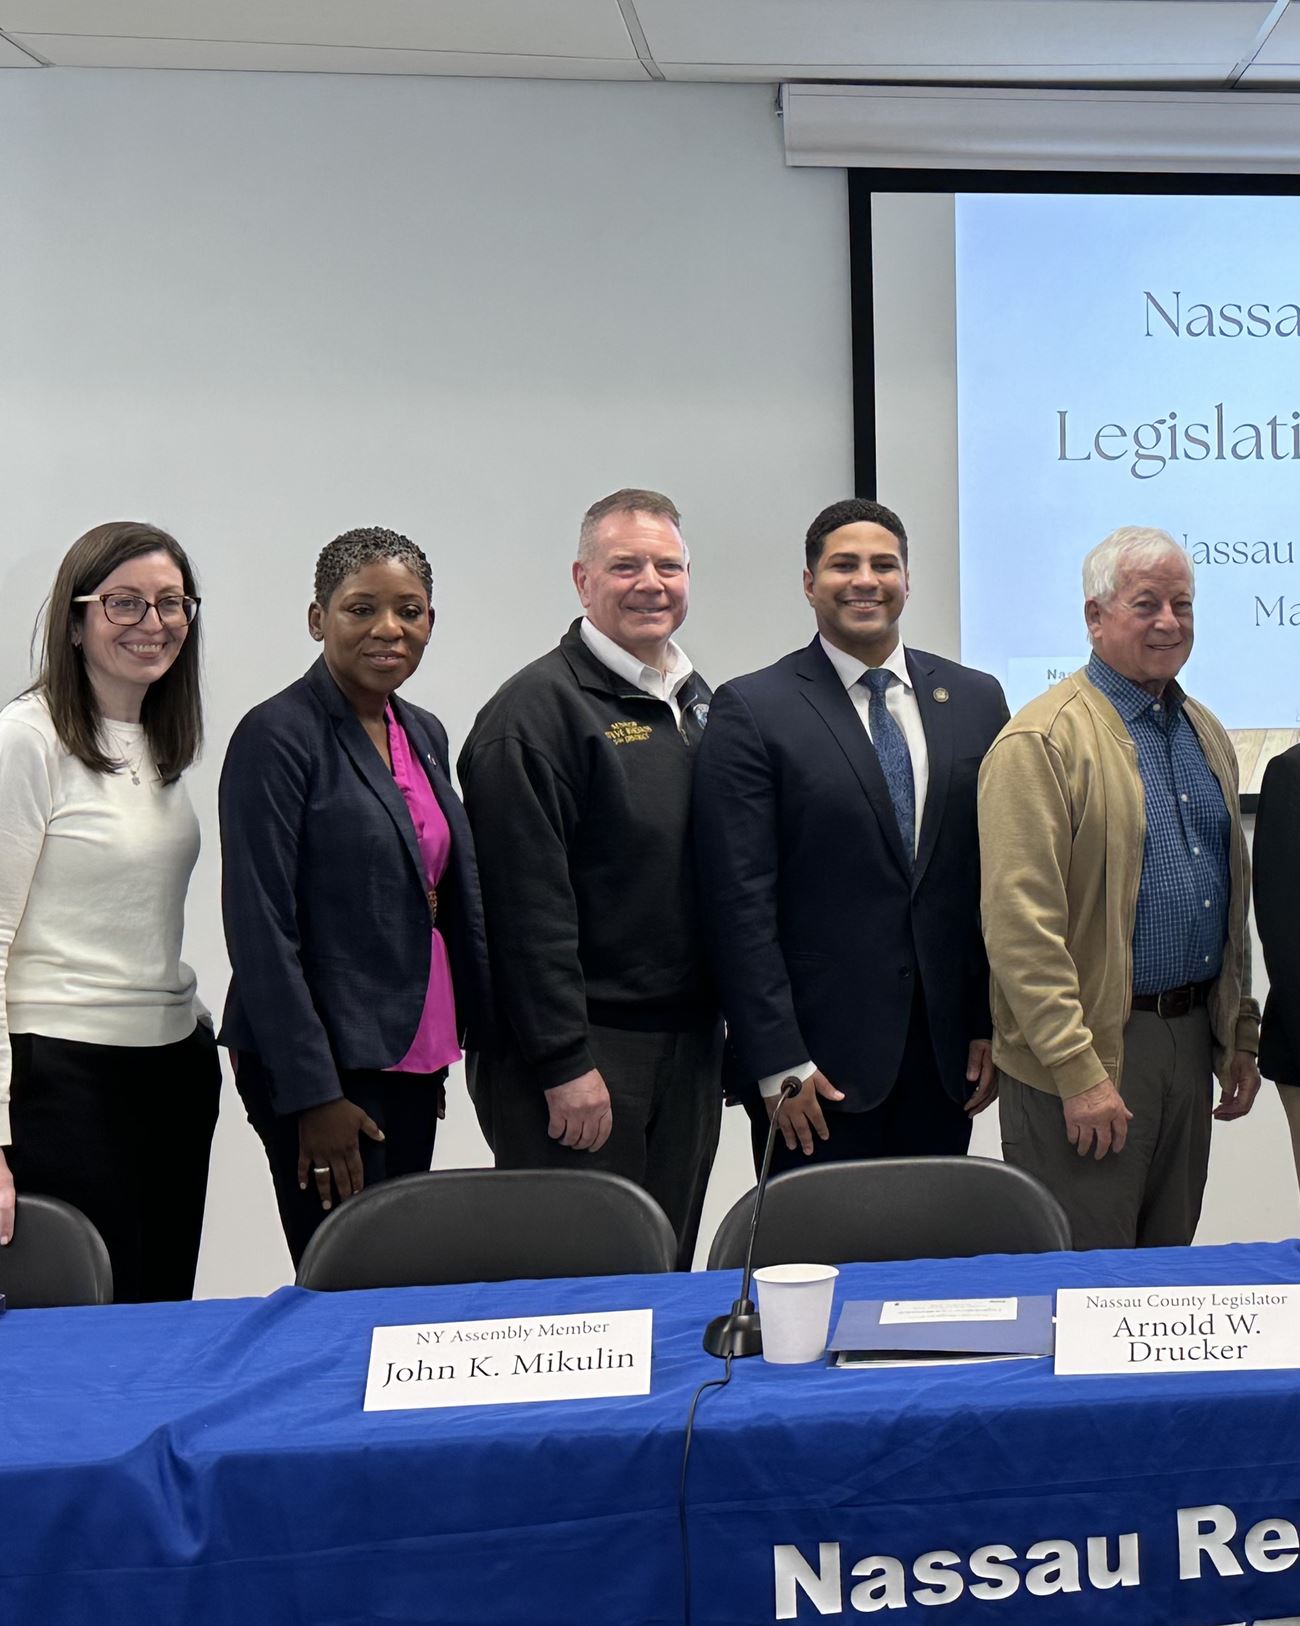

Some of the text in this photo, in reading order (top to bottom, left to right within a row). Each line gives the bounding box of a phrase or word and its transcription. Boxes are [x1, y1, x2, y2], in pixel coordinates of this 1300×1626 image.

[1182, 533, 1294, 565] assau
[1086, 1291, 1288, 1311] Nassau County Legislator
[416, 1320, 610, 1345] NY Assembly Member
[1112, 1313, 1261, 1338] Arnold W.
[1127, 1338, 1248, 1363] Drucker
[382, 1347, 634, 1388] John K. Mikulin
[773, 1532, 1141, 1620] Nassau
